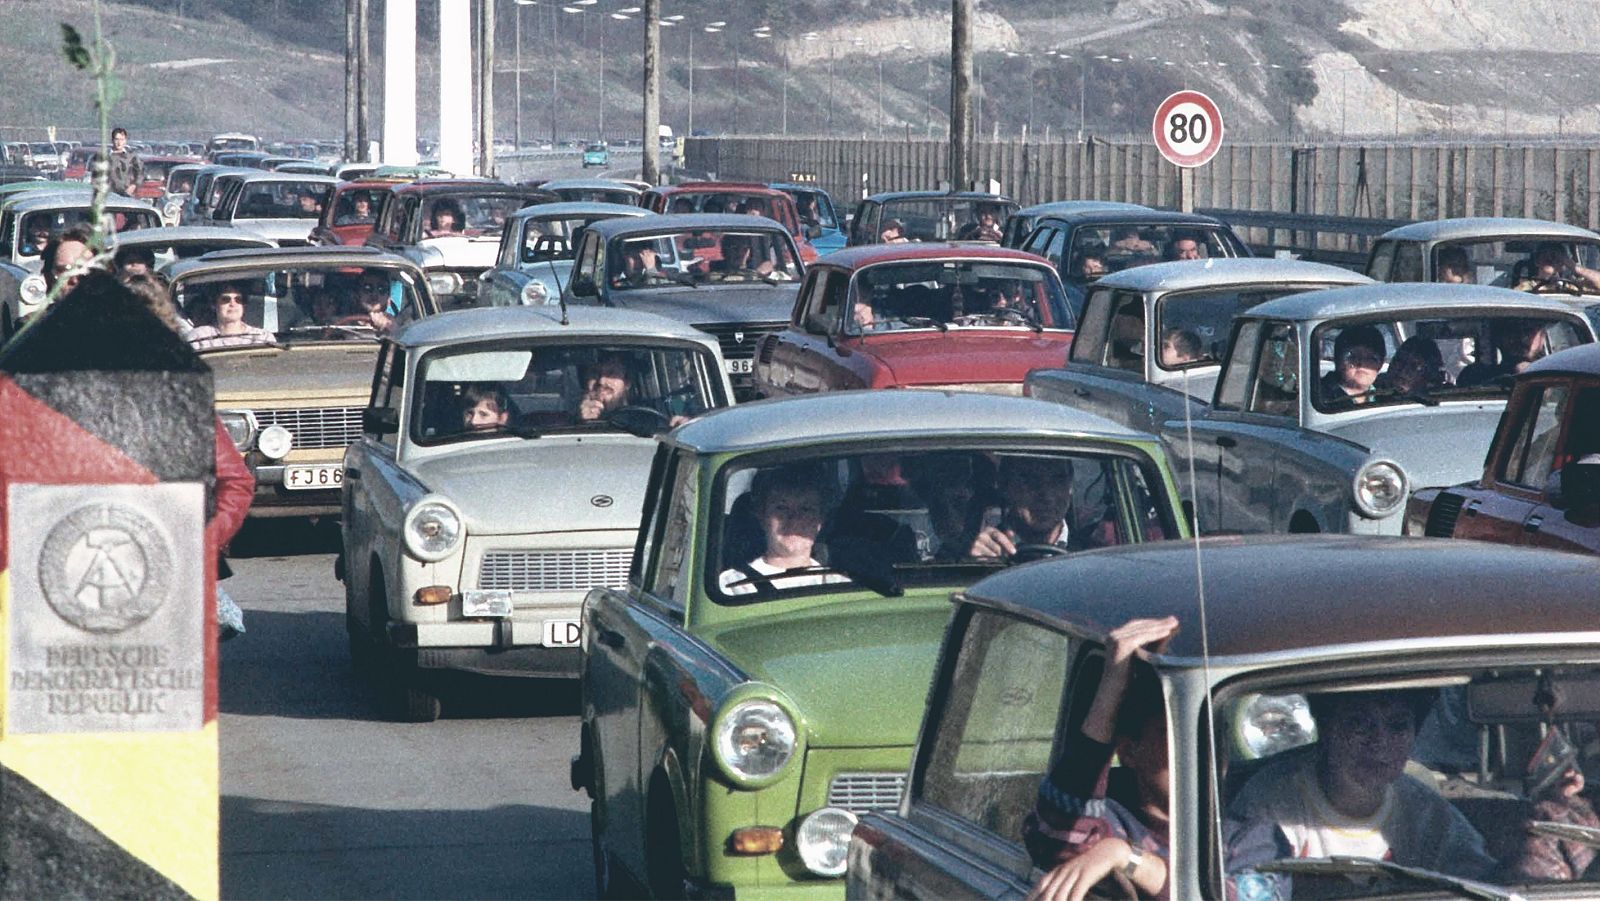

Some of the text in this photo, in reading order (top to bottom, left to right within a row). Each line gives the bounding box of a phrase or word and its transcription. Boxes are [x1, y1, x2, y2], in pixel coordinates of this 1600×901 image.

[1170, 113, 1207, 144] 80
[792, 174, 816, 182] TAXI
[290, 469, 343, 484] FJ66
[551, 622, 581, 644] LD
[45, 645, 169, 668] DEUTSCHE
[48, 691, 166, 715] REPUBLIK
